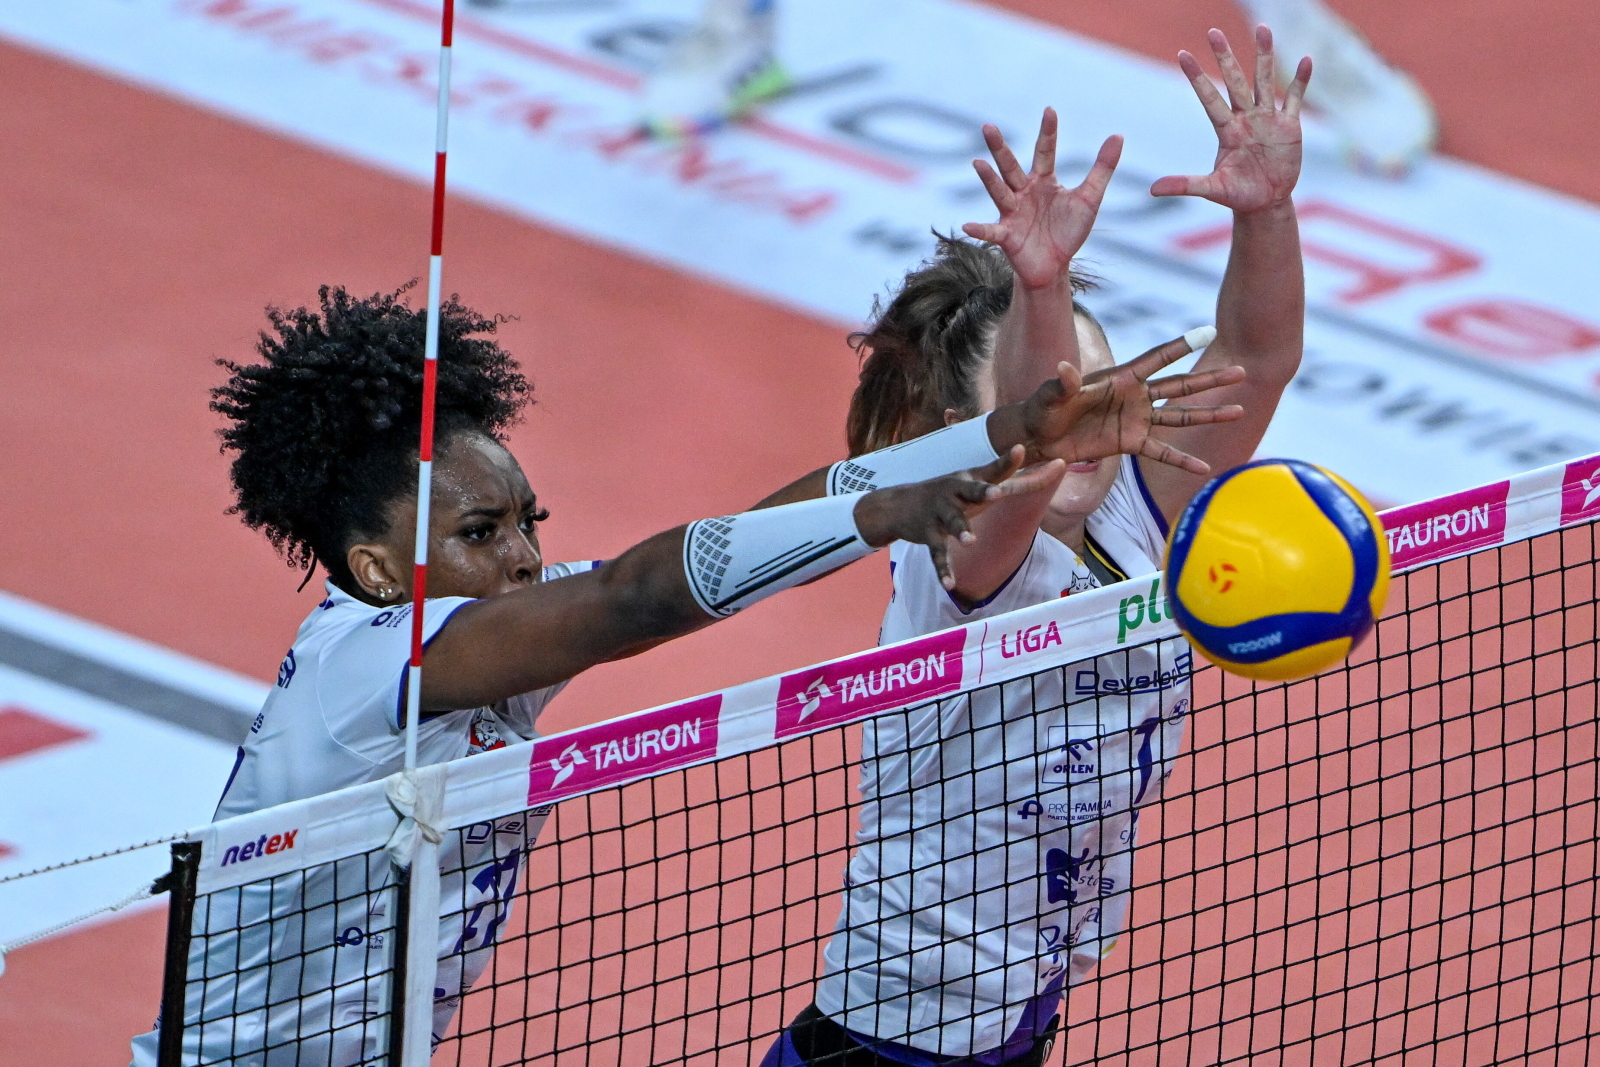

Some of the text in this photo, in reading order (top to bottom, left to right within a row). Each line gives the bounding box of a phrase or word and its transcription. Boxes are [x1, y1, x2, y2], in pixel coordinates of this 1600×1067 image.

[1385, 503, 1489, 554] TAURON
[1001, 621, 1062, 659] LIGA
[837, 652, 946, 704] TAURON
[590, 717, 702, 770] TAURON
[1053, 765, 1094, 773] ORLEN
[221, 829, 298, 867] netex
